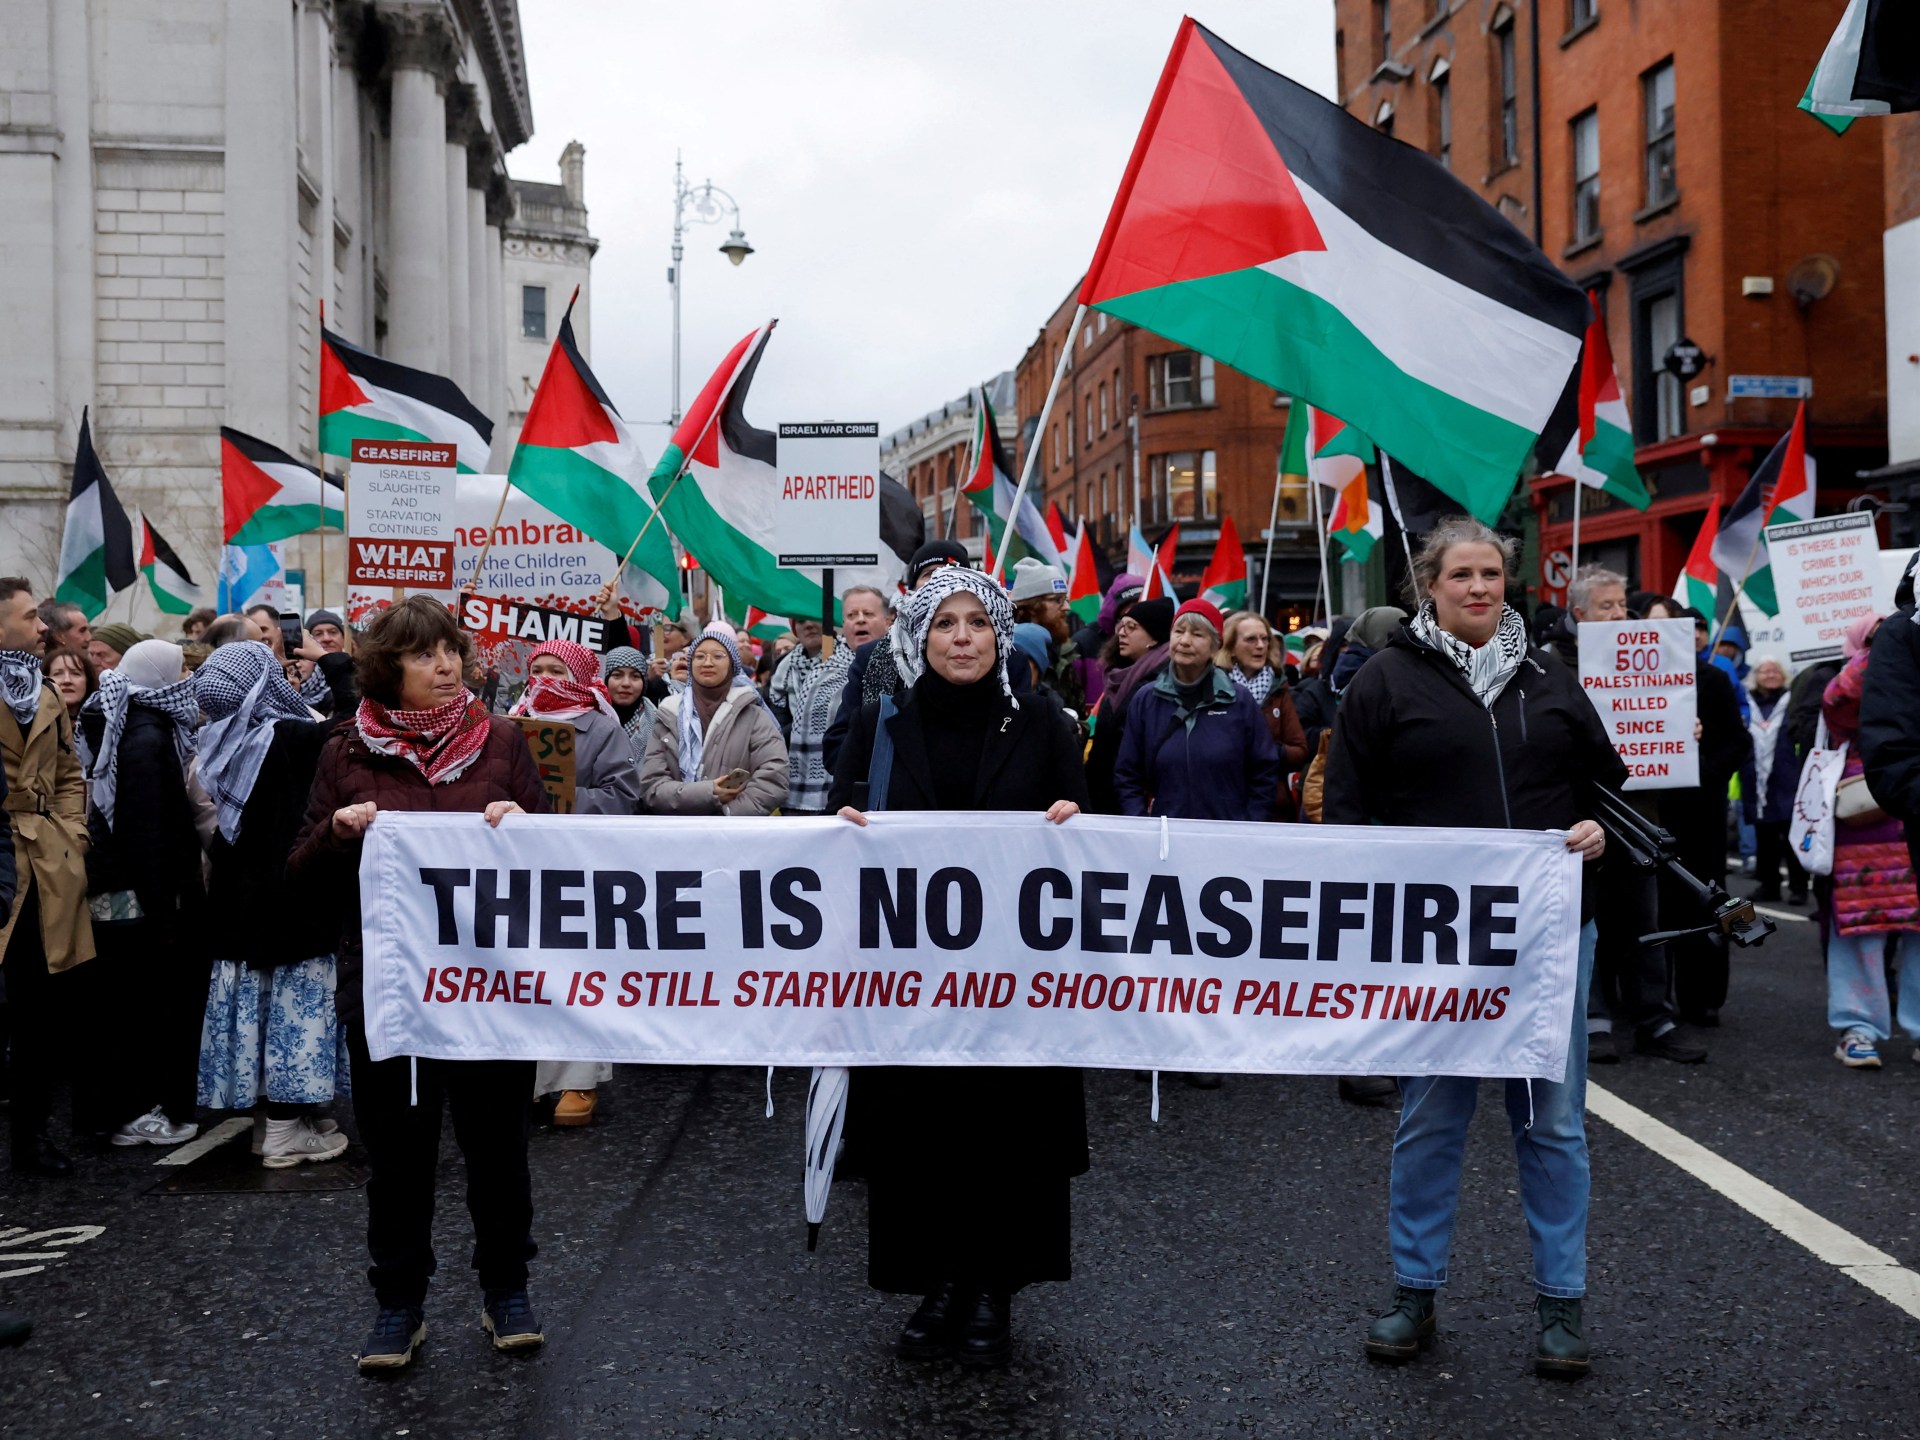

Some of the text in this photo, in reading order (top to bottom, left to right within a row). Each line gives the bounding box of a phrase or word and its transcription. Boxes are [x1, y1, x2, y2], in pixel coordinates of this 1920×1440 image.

[781, 424, 877, 435] ISRAELI WAR CRIME
[358, 447, 450, 463] CEASEFIRE?
[379, 469, 431, 481] ISRAEL'S
[368, 482, 441, 495] SLAUGHTER
[782, 475, 875, 500] APARTHEID
[391, 497, 418, 508] AND
[366, 509, 441, 522] STARVATION
[368, 523, 439, 536] CONTINUES
[1810, 520, 1835, 533] WAR
[1836, 516, 1868, 529] CRIME
[1788, 535, 1862, 556] IS THERE ANY
[357, 543, 446, 568] WHAT
[461, 554, 478, 571] of
[482, 554, 510, 570] the
[514, 553, 586, 569] Children
[1802, 553, 1854, 571] CRIME BY
[355, 567, 446, 582] CEASEFIRE?
[488, 573, 535, 589] Killed
[539, 572, 556, 587] in
[560, 571, 601, 586] Gaza
[1801, 570, 1863, 589] WHICH OUR
[1797, 587, 1872, 608] GOVERNMENT
[463, 599, 604, 650] SHAME
[1803, 612, 1830, 625] WILL
[1616, 632, 1660, 646] OVER
[1615, 648, 1660, 672] 500
[1583, 673, 1694, 689] PALESTINIANS
[1612, 697, 1668, 712] KILLED
[1616, 720, 1665, 735] SINCE
[523, 727, 573, 760] rse
[418, 866, 1519, 967] THERE IS NO CEASEFIRE
[422, 967, 1510, 1023] ISRAEL IS STILL STARVING AND SHOOTING PALESTINIANS
